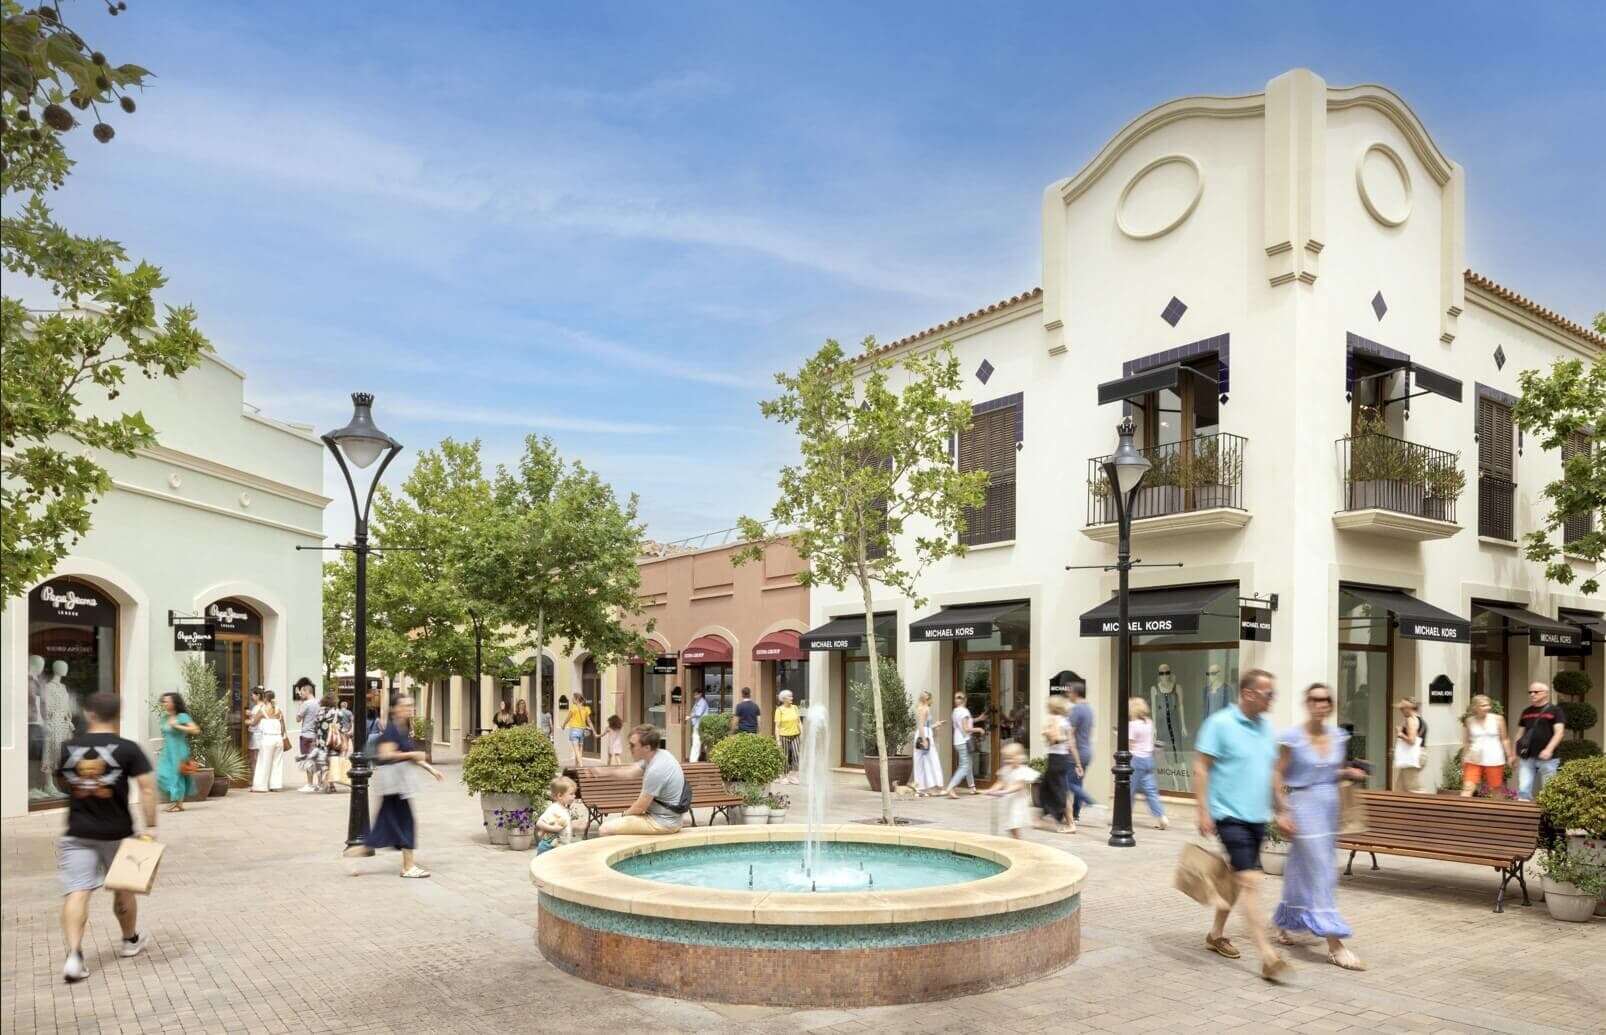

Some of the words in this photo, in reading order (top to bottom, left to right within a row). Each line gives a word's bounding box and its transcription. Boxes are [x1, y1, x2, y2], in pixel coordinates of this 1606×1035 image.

[41, 586, 67, 607] Pepe
[65, 591, 97, 609] Jeans
[210, 604, 227, 621] Pepe
[225, 608, 248, 623] Jeans
[1103, 622, 1143, 632] MICAEL
[1145, 620, 1172, 630] KORS
[1415, 625, 1440, 637] MICHAEL
[1441, 628, 1456, 638] KORS
[177, 630, 193, 642] Pepe
[192, 632, 212, 642] Jeans
[925, 628, 953, 638] MICHAEL
[955, 627, 974, 637] KORS
[1541, 632, 1560, 643] MICHAEL
[1560, 635, 1571, 644] KORS
[811, 641, 833, 649] MICHAEL
[833, 640, 848, 648] KORS
